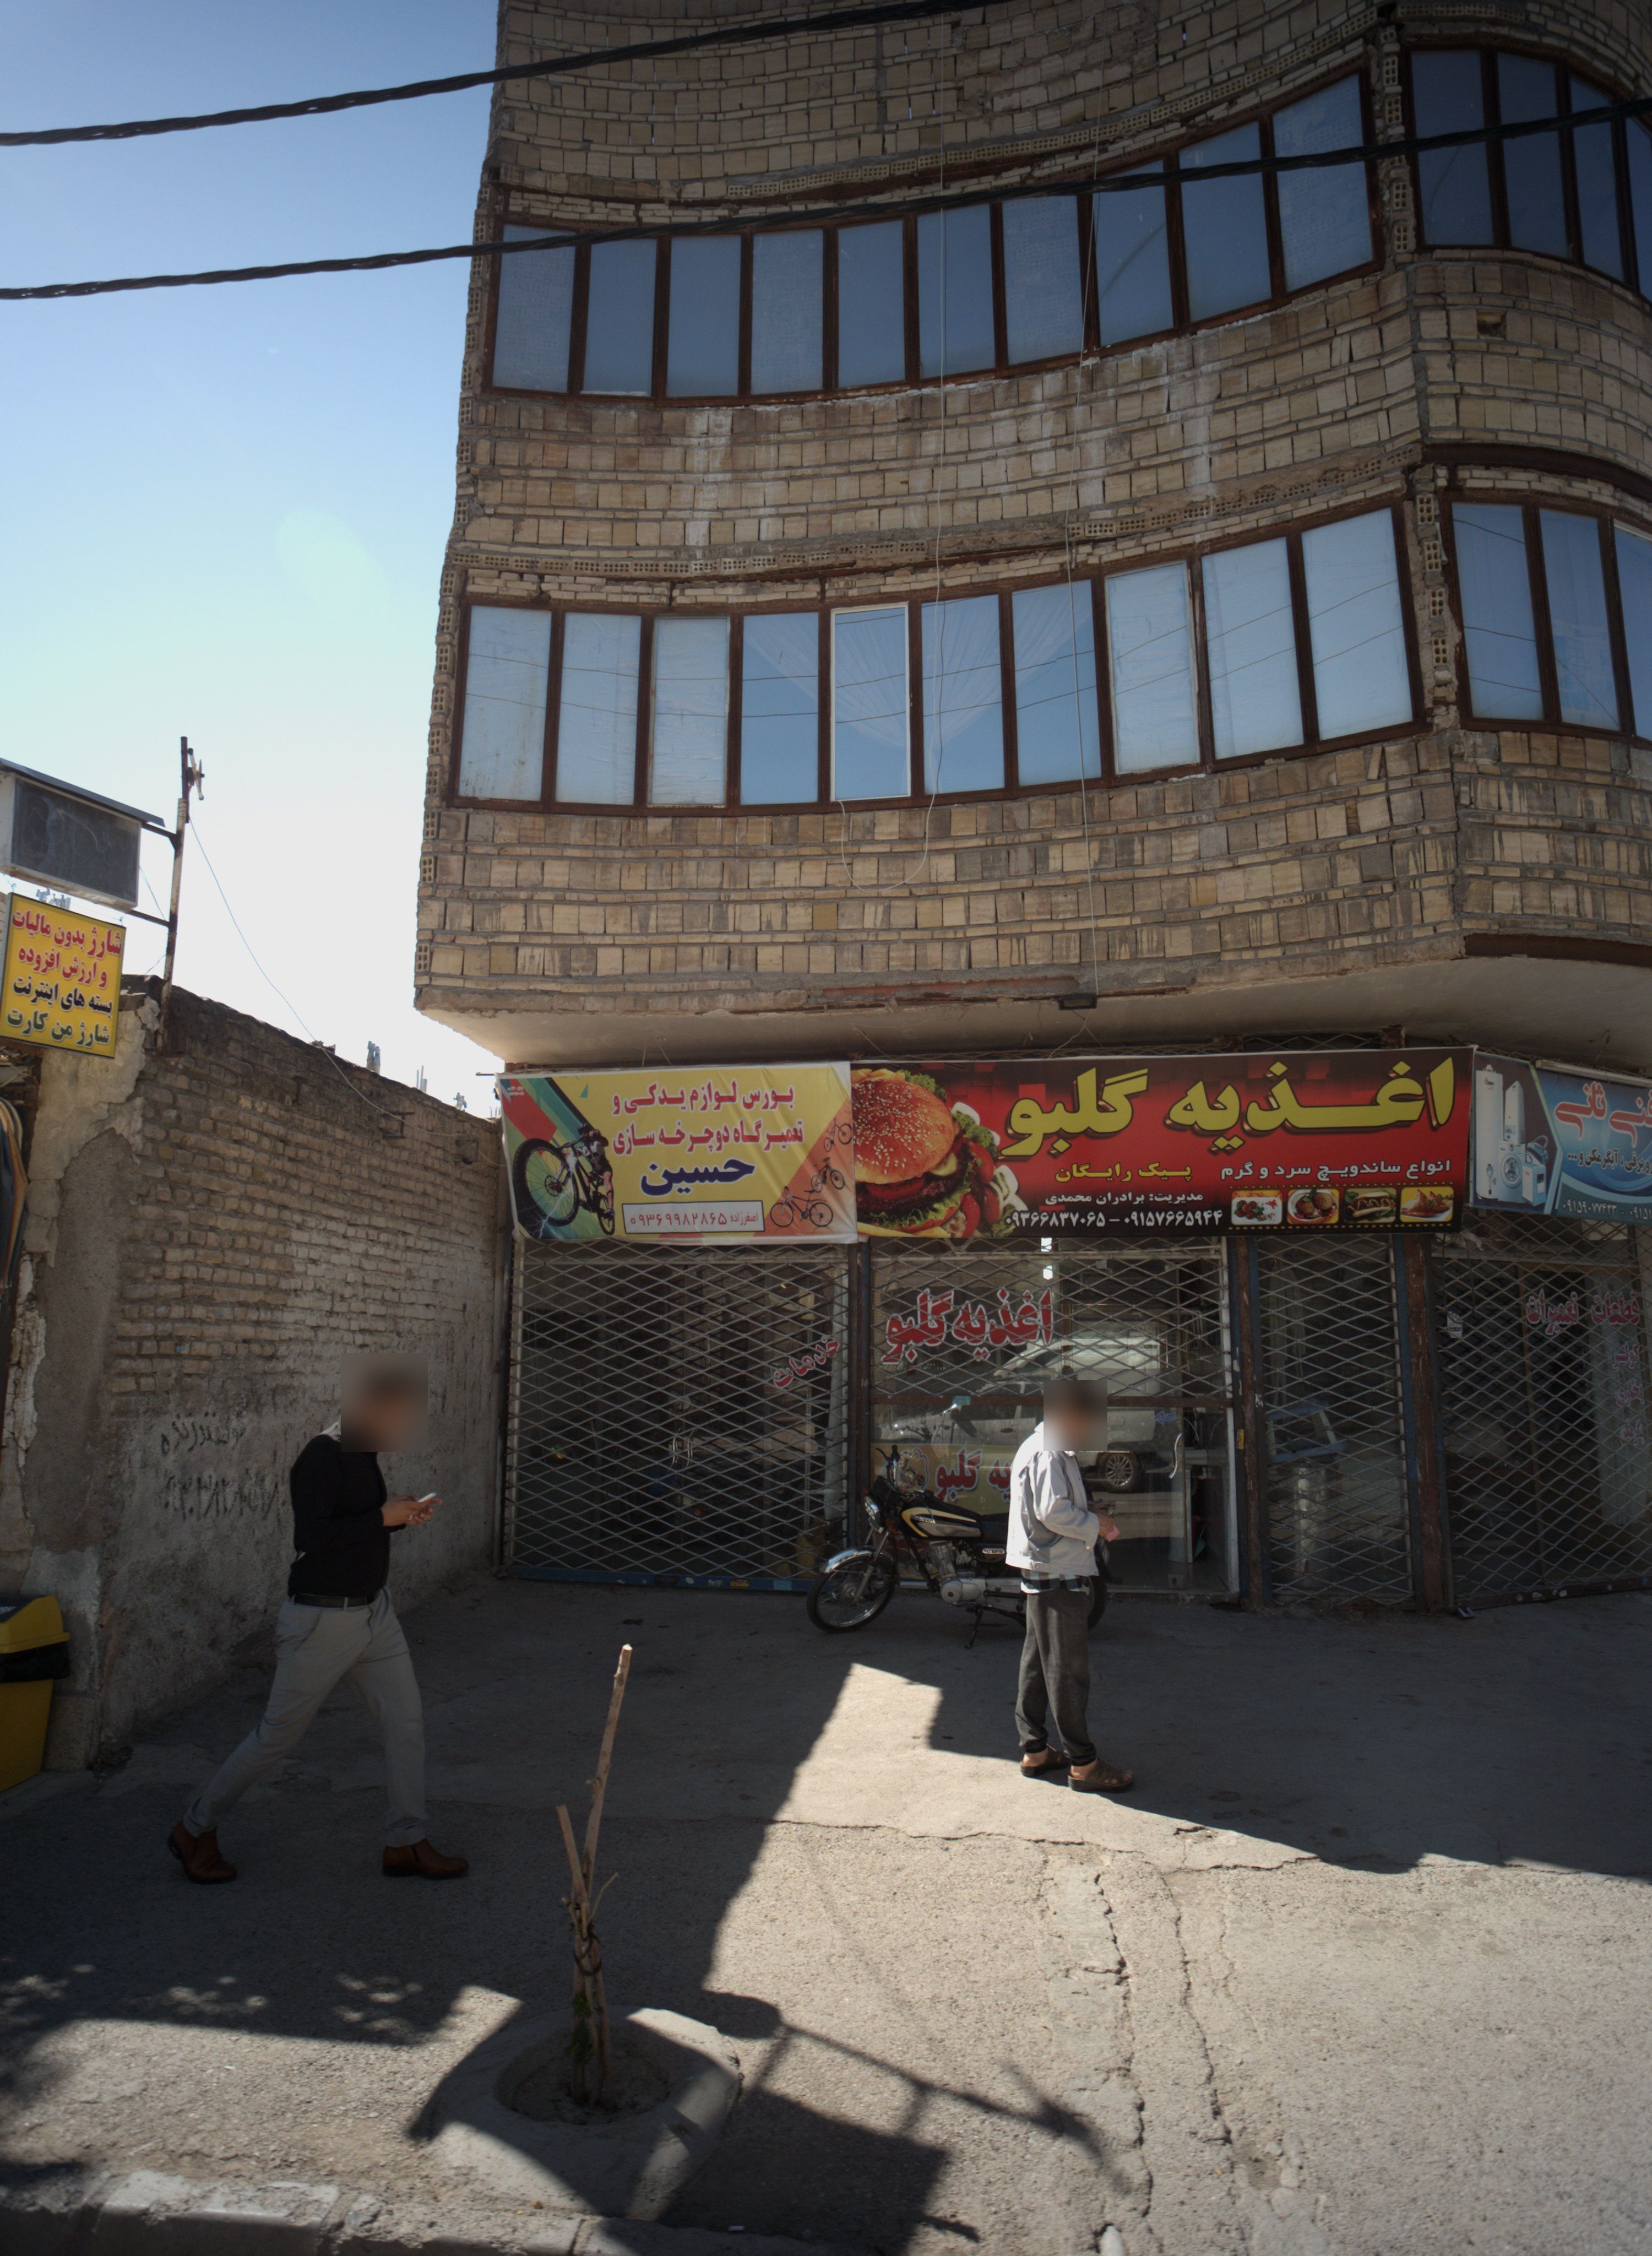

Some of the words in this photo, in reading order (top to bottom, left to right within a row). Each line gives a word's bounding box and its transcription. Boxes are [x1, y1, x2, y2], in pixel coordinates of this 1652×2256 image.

[12, 910, 51, 936] مالیات
[53, 926, 85, 951] بدون
[87, 926, 122, 959] شارژ
[18, 947, 61, 974] افزوده
[62, 956, 97, 985] ارزش
[13, 976, 58, 1006] اینترنت
[99, 969, 108, 988] و
[61, 987, 85, 1011] های
[89, 995, 113, 1019] بسته
[7, 1009, 49, 1035] کارت
[51, 1021, 73, 1041] من
[77, 1022, 110, 1047] شارژ
[612, 1094, 621, 1115] و
[623, 1083, 685, 1114] یدکی
[689, 1080, 737, 1111] لوازم
[742, 1085, 795, 1111] بورس
[1166, 1057, 1454, 1152] اغذیه
[999, 1067, 1149, 1158] گلبو
[612, 1122, 656, 1155] سازی
[658, 1120, 730, 1153] دوچرخه
[640, 1159, 756, 1197] حسین
[1055, 1162, 1133, 1183] رایگان
[1138, 1162, 1192, 1181] پیک
[1220, 1161, 1254, 1180] گرم
[1259, 1166, 1269, 1179] و
[1274, 1165, 1312, 1179] سرد
[1317, 1160, 1401, 1181] ساندویچ
[1406, 1159, 1451, 1180] انواع
[1045, 1192, 1093, 1206] محمدی
[1096, 1191, 1145, 1206] برادران
[880, 1288, 955, 1365] گلبو
[952, 1287, 1054, 1362] اغذیه
[936, 1446, 983, 1502] گلبو
